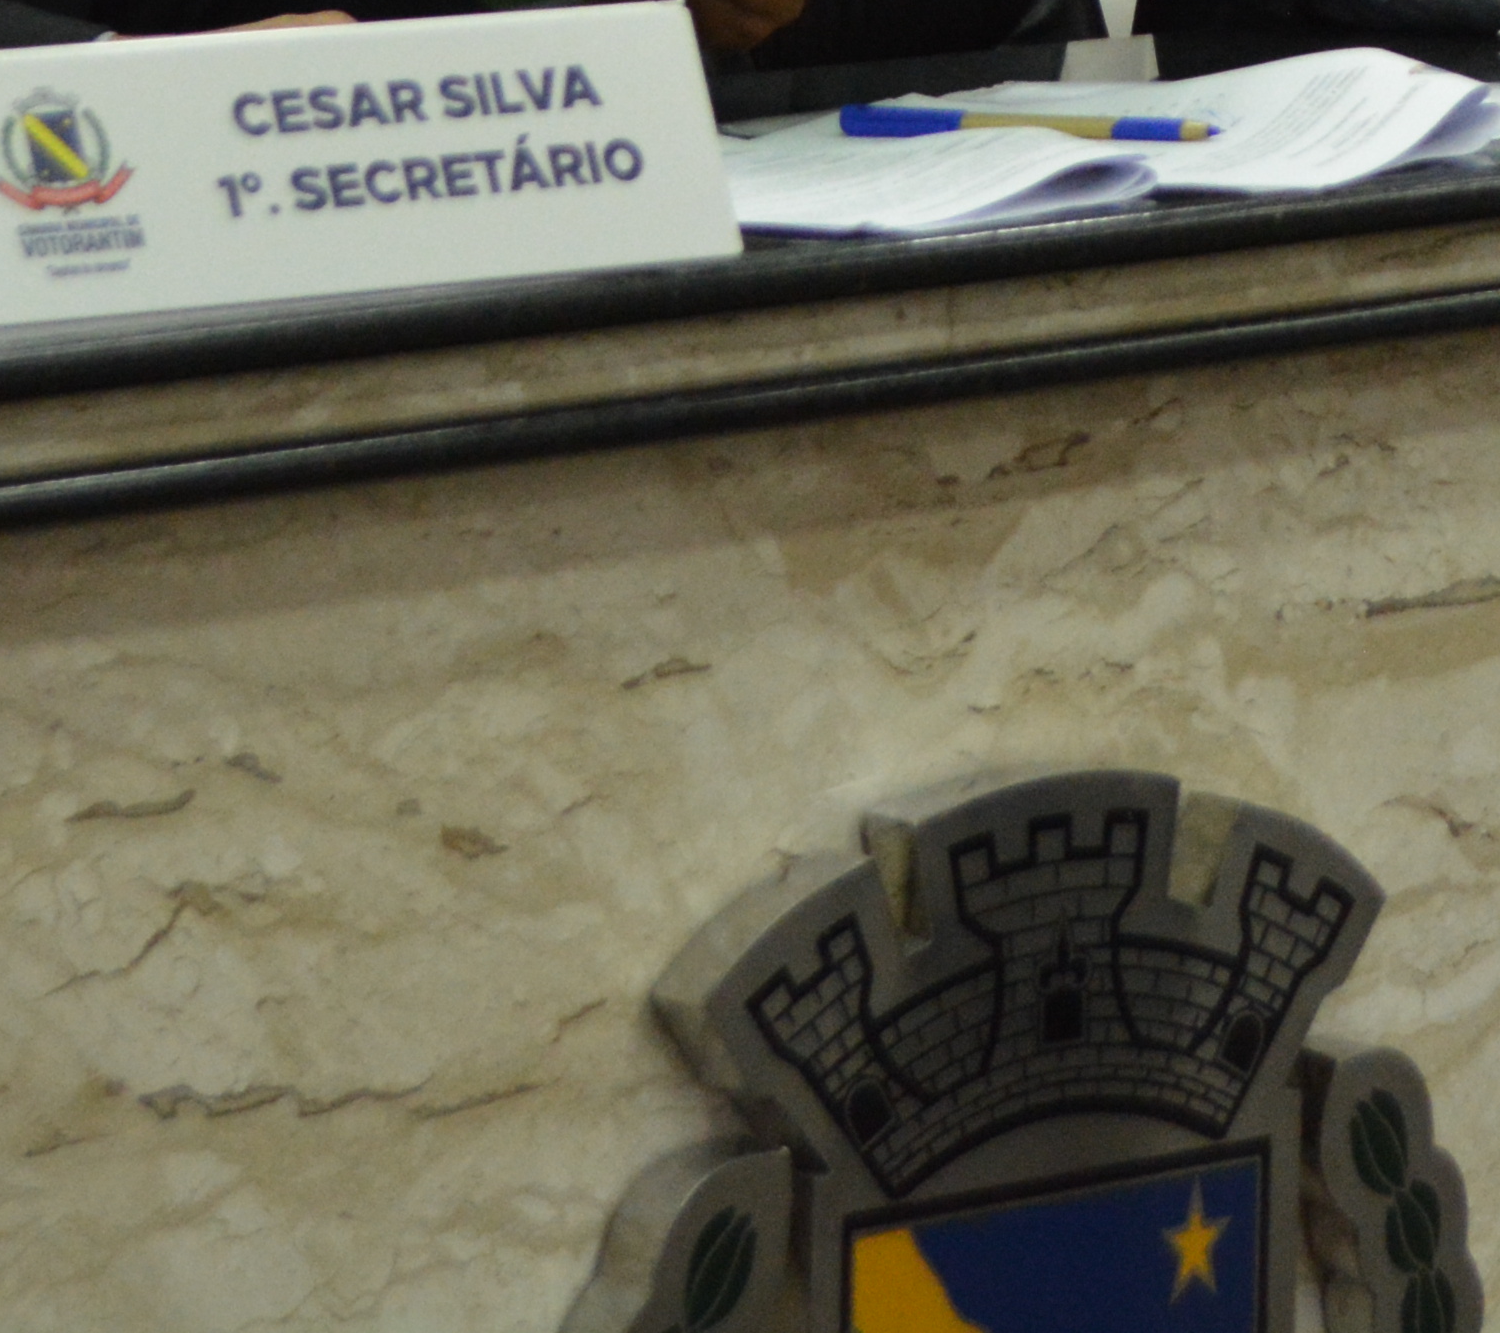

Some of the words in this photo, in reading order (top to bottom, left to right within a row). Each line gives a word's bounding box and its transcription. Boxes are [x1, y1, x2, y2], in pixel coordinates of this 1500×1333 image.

[233, 78, 428, 135] CESAR
[439, 64, 603, 119] SILVA
[290, 133, 644, 211] SECRETÁRIO
[21, 228, 145, 258] VOTORANTIM
